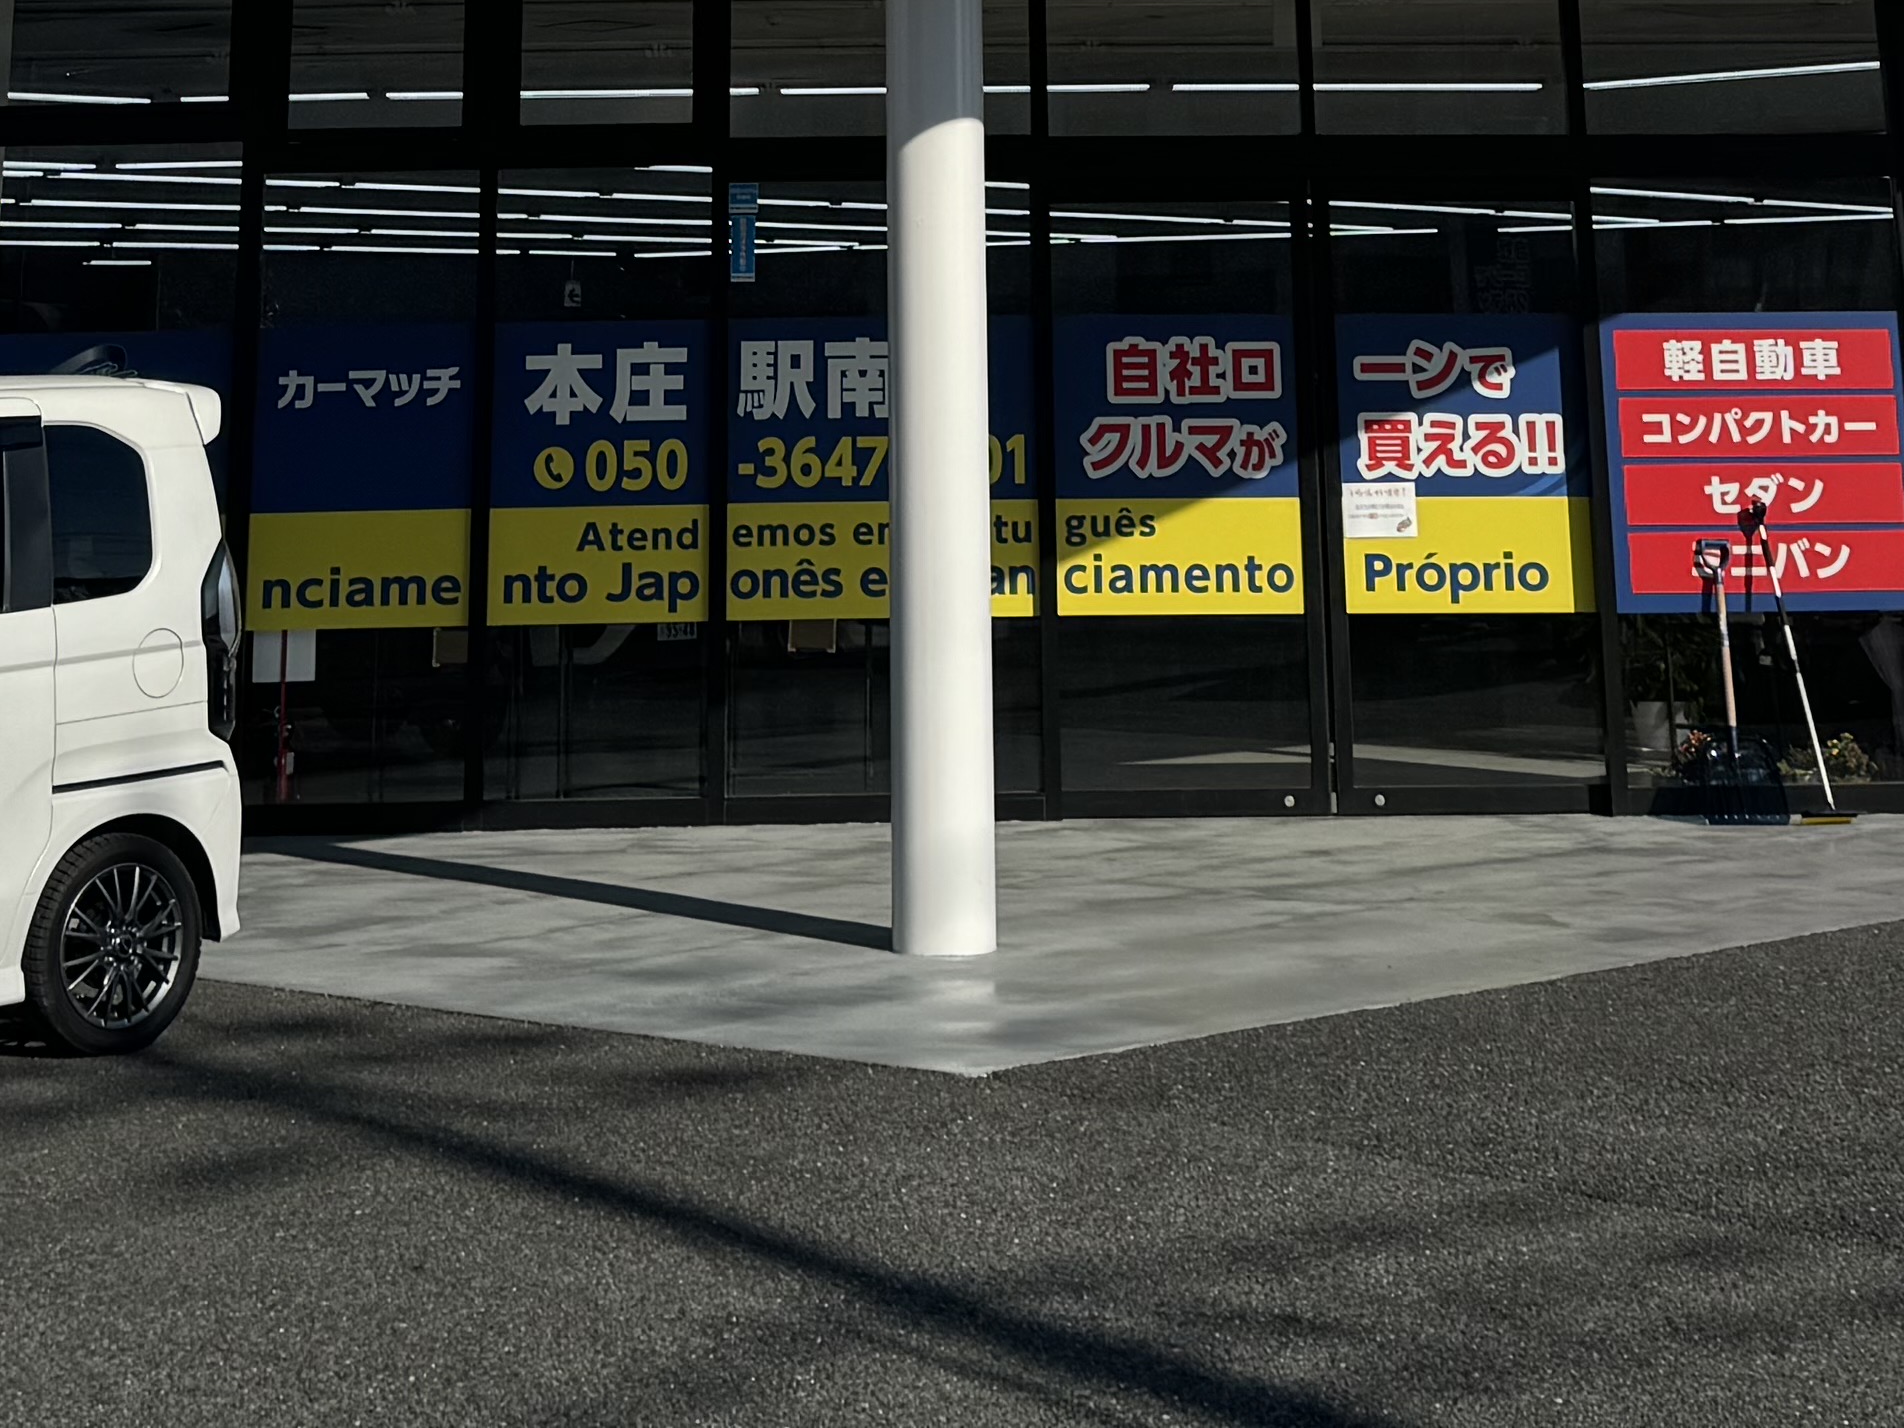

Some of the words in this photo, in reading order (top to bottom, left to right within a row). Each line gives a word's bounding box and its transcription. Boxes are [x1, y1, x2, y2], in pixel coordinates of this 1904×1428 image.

[1662, 338, 1842, 382] 軽自動車
[277, 366, 462, 409] カーマッチ
[1641, 407, 1877, 445] コンパクトカー
[1703, 472, 1825, 515] セダン
[1363, 550, 1550, 605] Próprio
